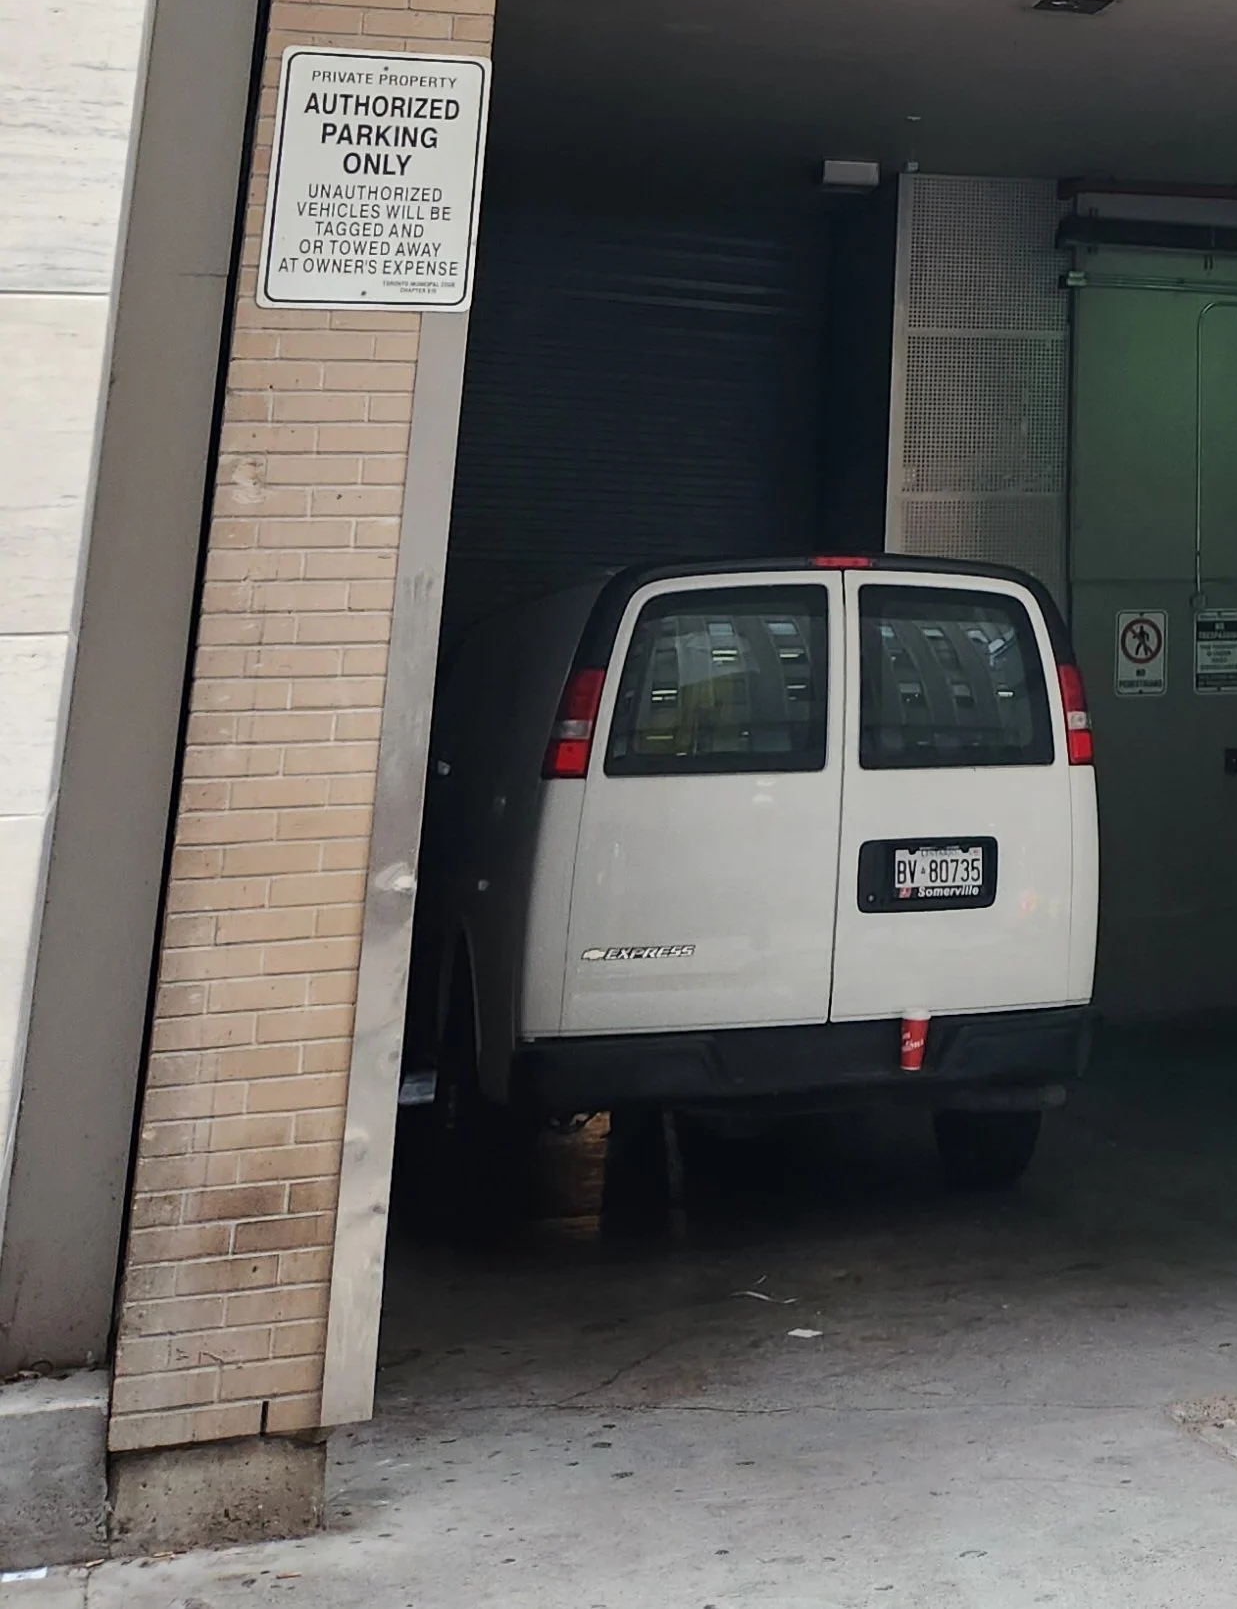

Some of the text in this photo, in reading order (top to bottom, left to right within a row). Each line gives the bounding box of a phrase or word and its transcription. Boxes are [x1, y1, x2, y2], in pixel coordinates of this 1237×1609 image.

[312, 70, 458, 89] PRIVATE PROPERTY
[304, 92, 460, 120] AUTHORIZED
[321, 123, 439, 149] PARKING
[343, 152, 412, 176] ONLY
[308, 183, 443, 202] UNAUTHORIZED
[297, 202, 452, 221] VEHICLES WILL BE
[315, 221, 425, 238] TAGGED AND
[299, 239, 441, 258] OR TOWED AWAY
[278, 257, 459, 276] AT OWNER'S EXPENSE
[897, 858, 980, 884] BV 80735
[918, 885, 979, 898] Somerville
[604, 944, 696, 960] EXPRESS
